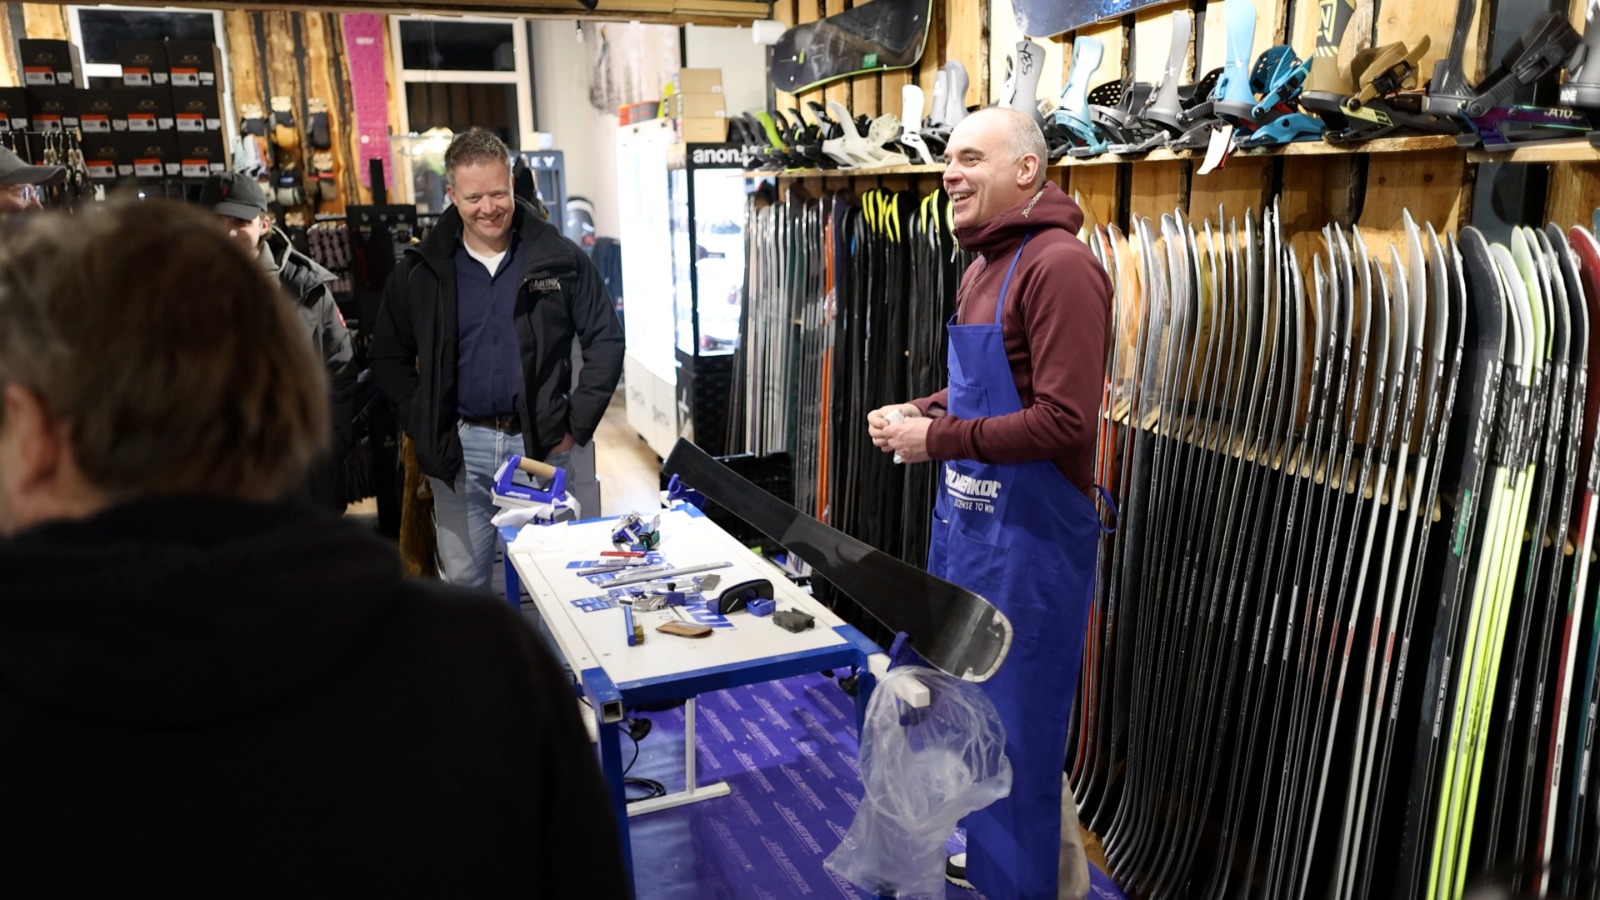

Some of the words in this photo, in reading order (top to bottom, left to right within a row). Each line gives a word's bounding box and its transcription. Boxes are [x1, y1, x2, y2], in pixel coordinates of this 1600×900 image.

[1560, 90, 1577, 101] IDE
[975, 502, 983, 511] TO
[985, 504, 995, 514] WIN
